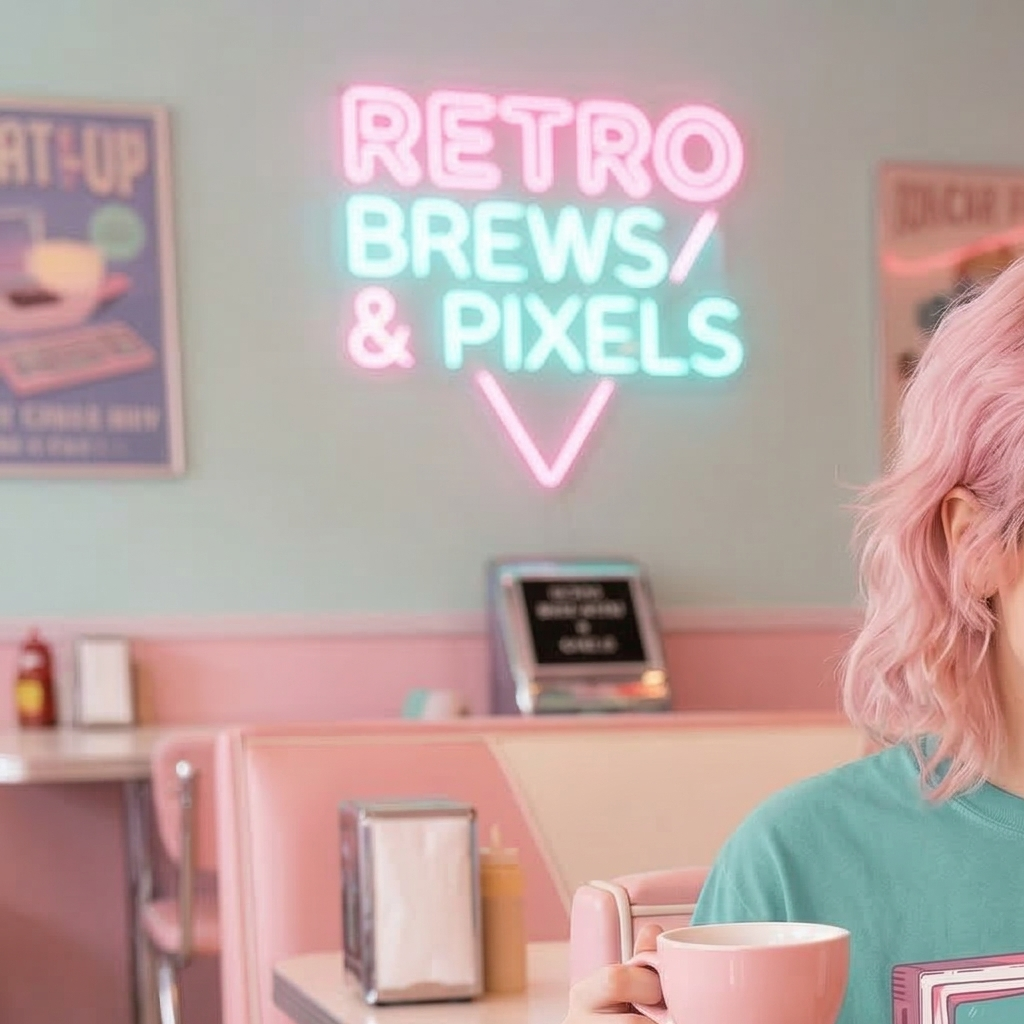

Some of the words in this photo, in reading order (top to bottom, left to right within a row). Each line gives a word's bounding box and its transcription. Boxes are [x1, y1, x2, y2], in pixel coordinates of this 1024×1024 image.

[341, 85, 744, 202] RETRO
[347, 286, 415, 370] &
[442, 289, 744, 378] PIXELS
